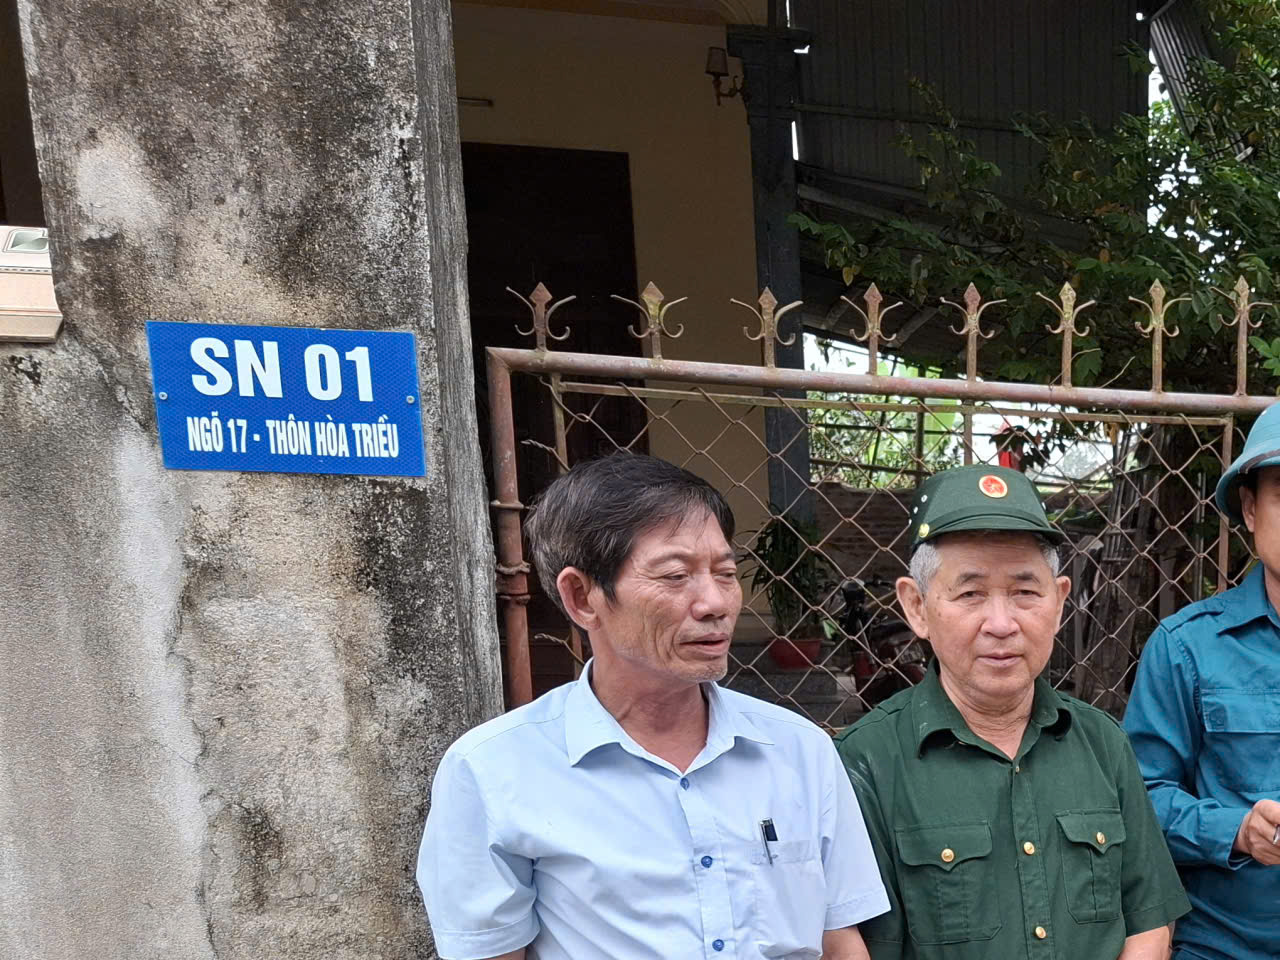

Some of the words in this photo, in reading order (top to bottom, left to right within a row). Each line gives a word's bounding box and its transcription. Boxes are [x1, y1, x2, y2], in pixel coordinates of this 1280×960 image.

[190, 337, 283, 397] SN
[304, 343, 374, 402] 01
[187, 411, 224, 452] NGÕ
[228, 418, 247, 453] 17
[265, 413, 312, 455] THÔN
[315, 415, 350, 457] HÒA
[352, 414, 399, 458] TRIỀU
